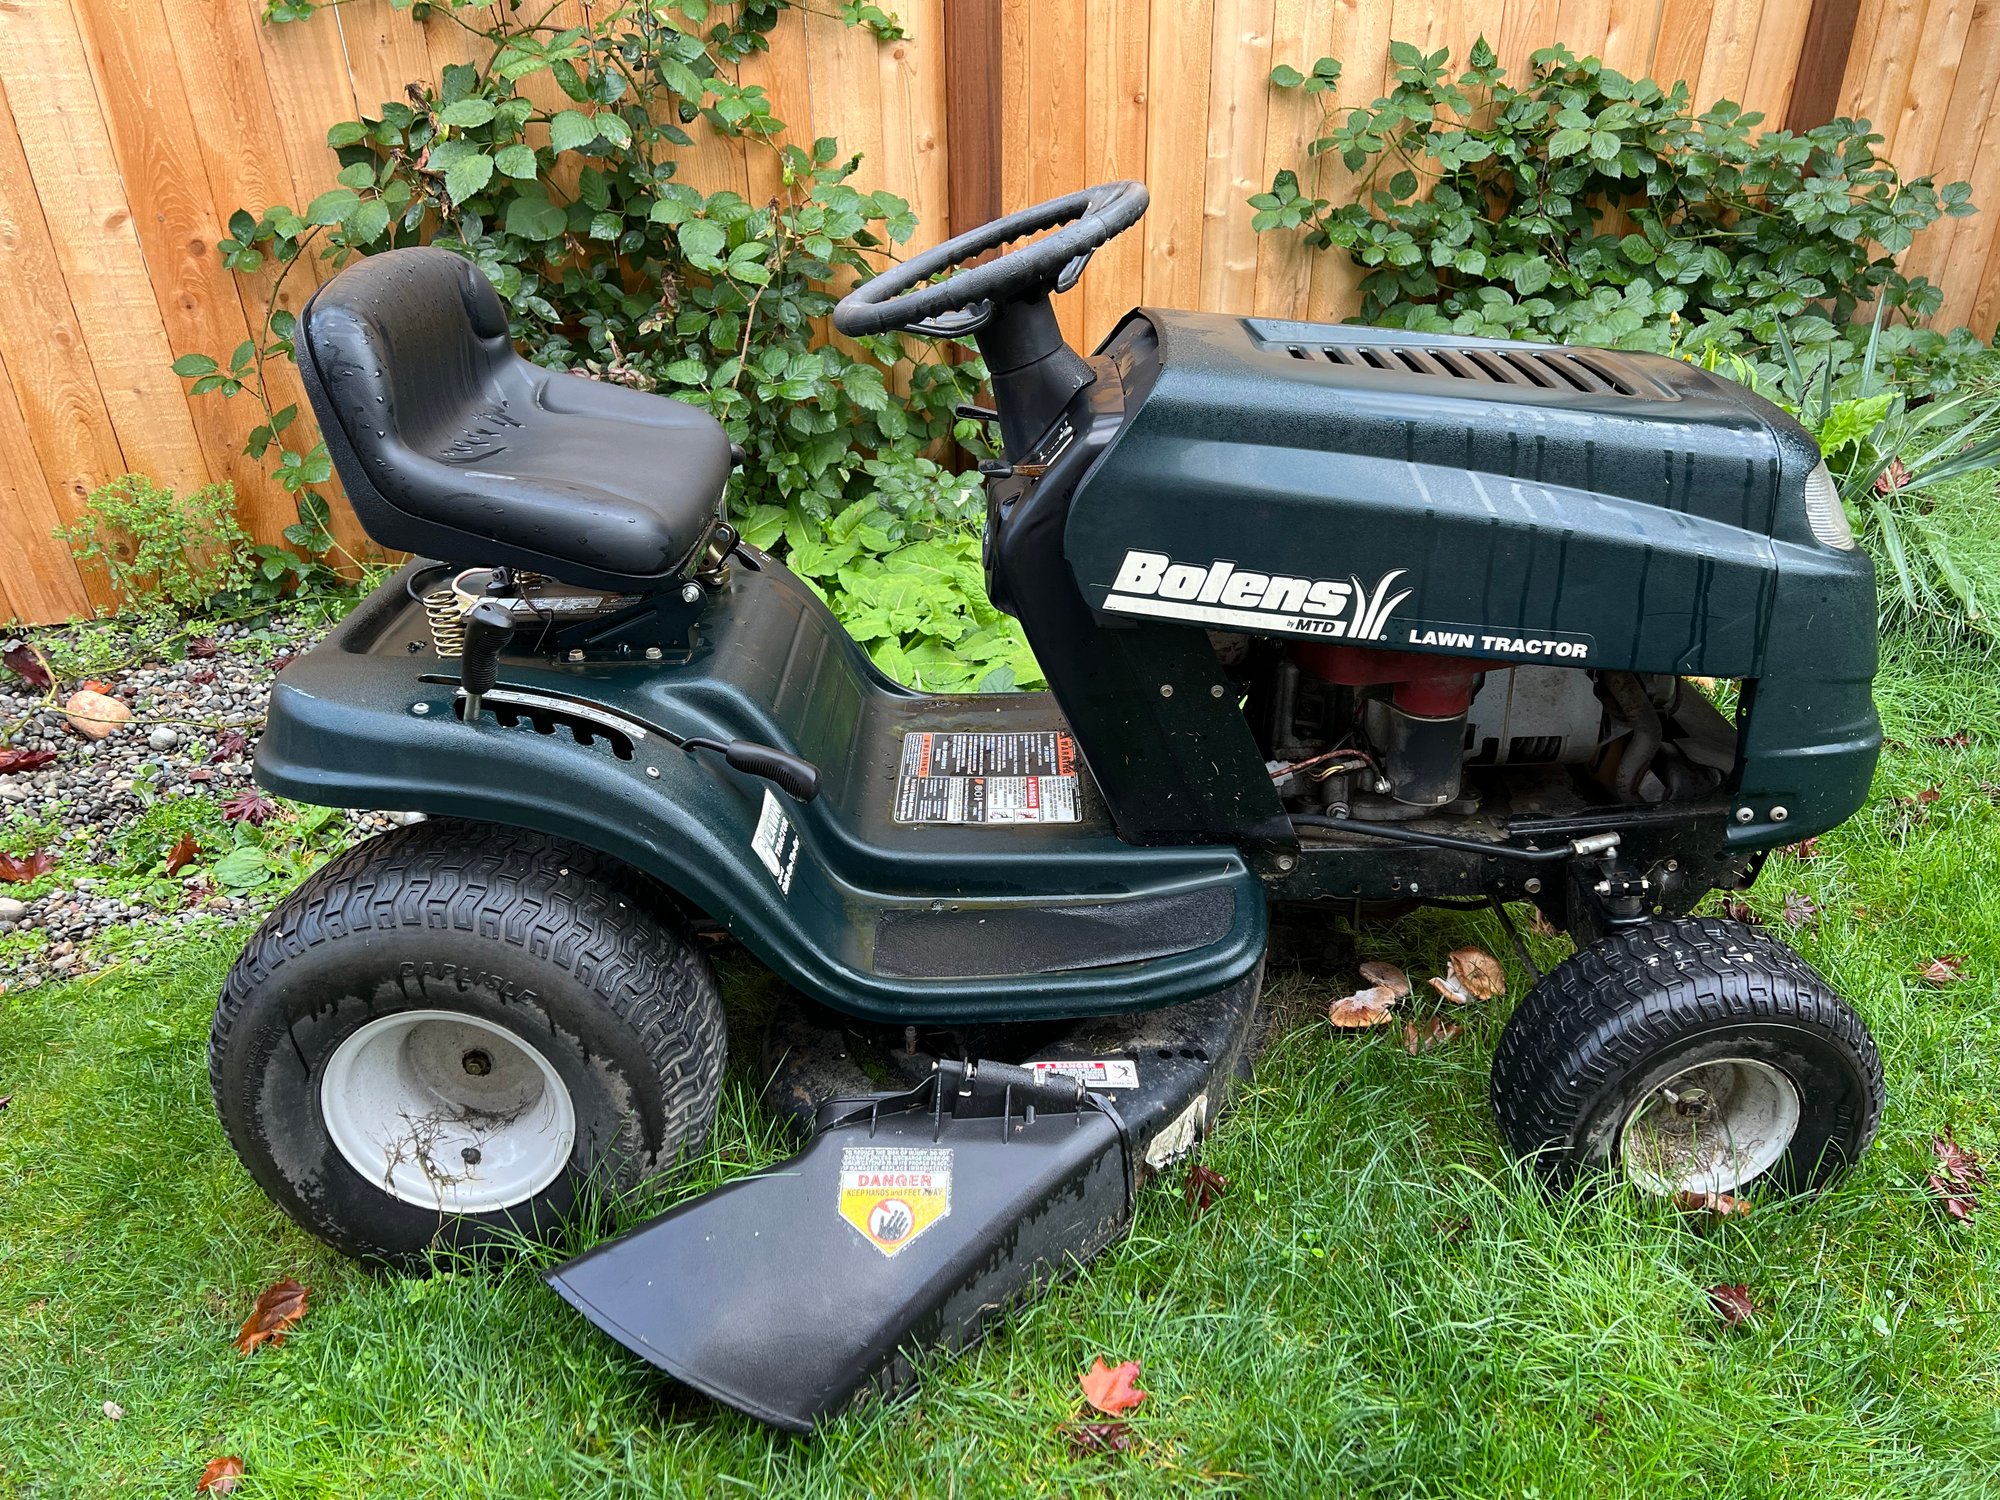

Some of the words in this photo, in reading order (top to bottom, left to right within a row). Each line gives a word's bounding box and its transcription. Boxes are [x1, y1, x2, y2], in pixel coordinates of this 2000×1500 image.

[1112, 549, 1353, 617] Bolens
[1286, 618, 1296, 630] by
[1295, 618, 1337, 634] MTD
[1408, 628, 1476, 650] LAWN
[1480, 634, 1589, 659] TRACTOR
[921, 744, 930, 771] WARNING
[1028, 783, 1037, 807] DANGER
[764, 799, 782, 847] LAWN
[398, 961, 538, 1006] CARLISLE
[847, 1189, 866, 1197] KEEP
[866, 1189, 889, 1197] HANDS
[890, 1189, 903, 1197] and
[904, 1188, 921, 1196] FEET
[857, 1174, 932, 1187] DANGER
